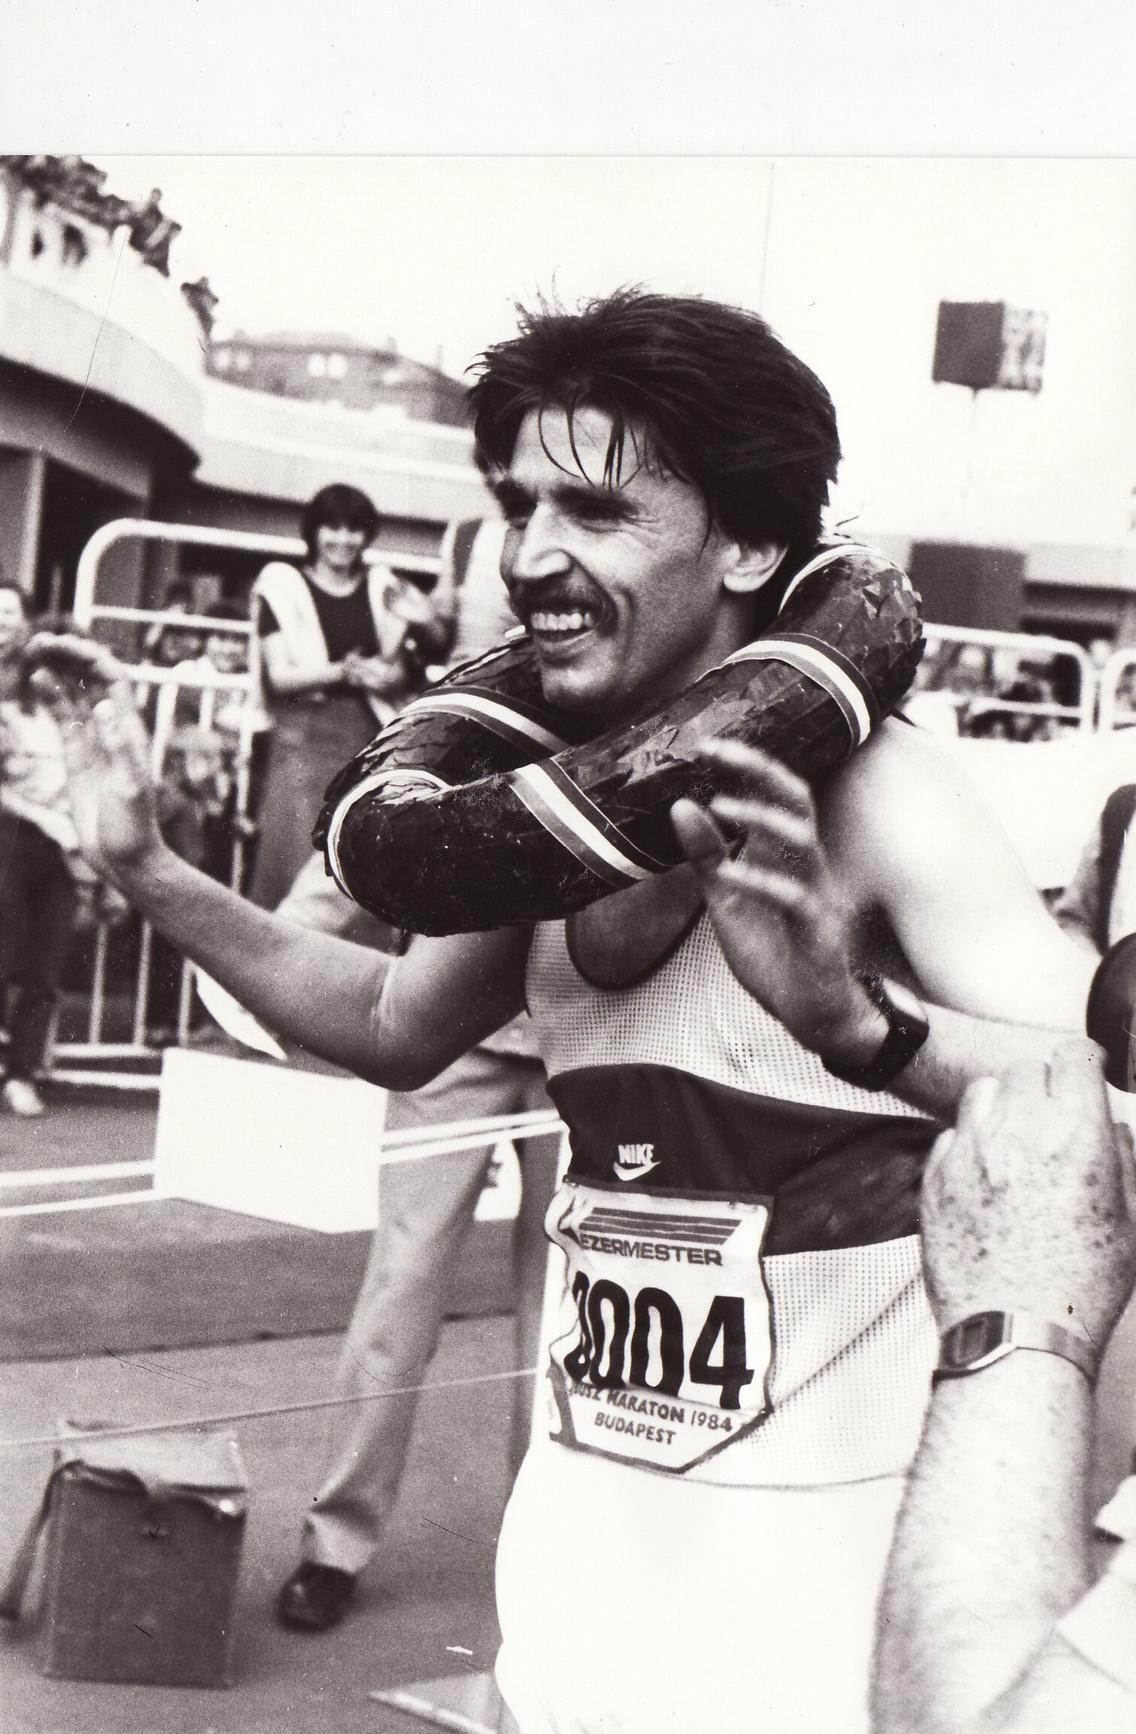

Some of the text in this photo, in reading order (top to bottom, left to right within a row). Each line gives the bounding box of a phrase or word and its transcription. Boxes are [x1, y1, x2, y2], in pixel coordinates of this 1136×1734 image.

[617, 1143, 654, 1165] NIKE
[580, 1233, 723, 1267] EZERMESTER
[606, 1388, 685, 1424] MARATON
[690, 1411, 733, 1433] 1984
[593, 1411, 677, 1445] BUDAPEST
